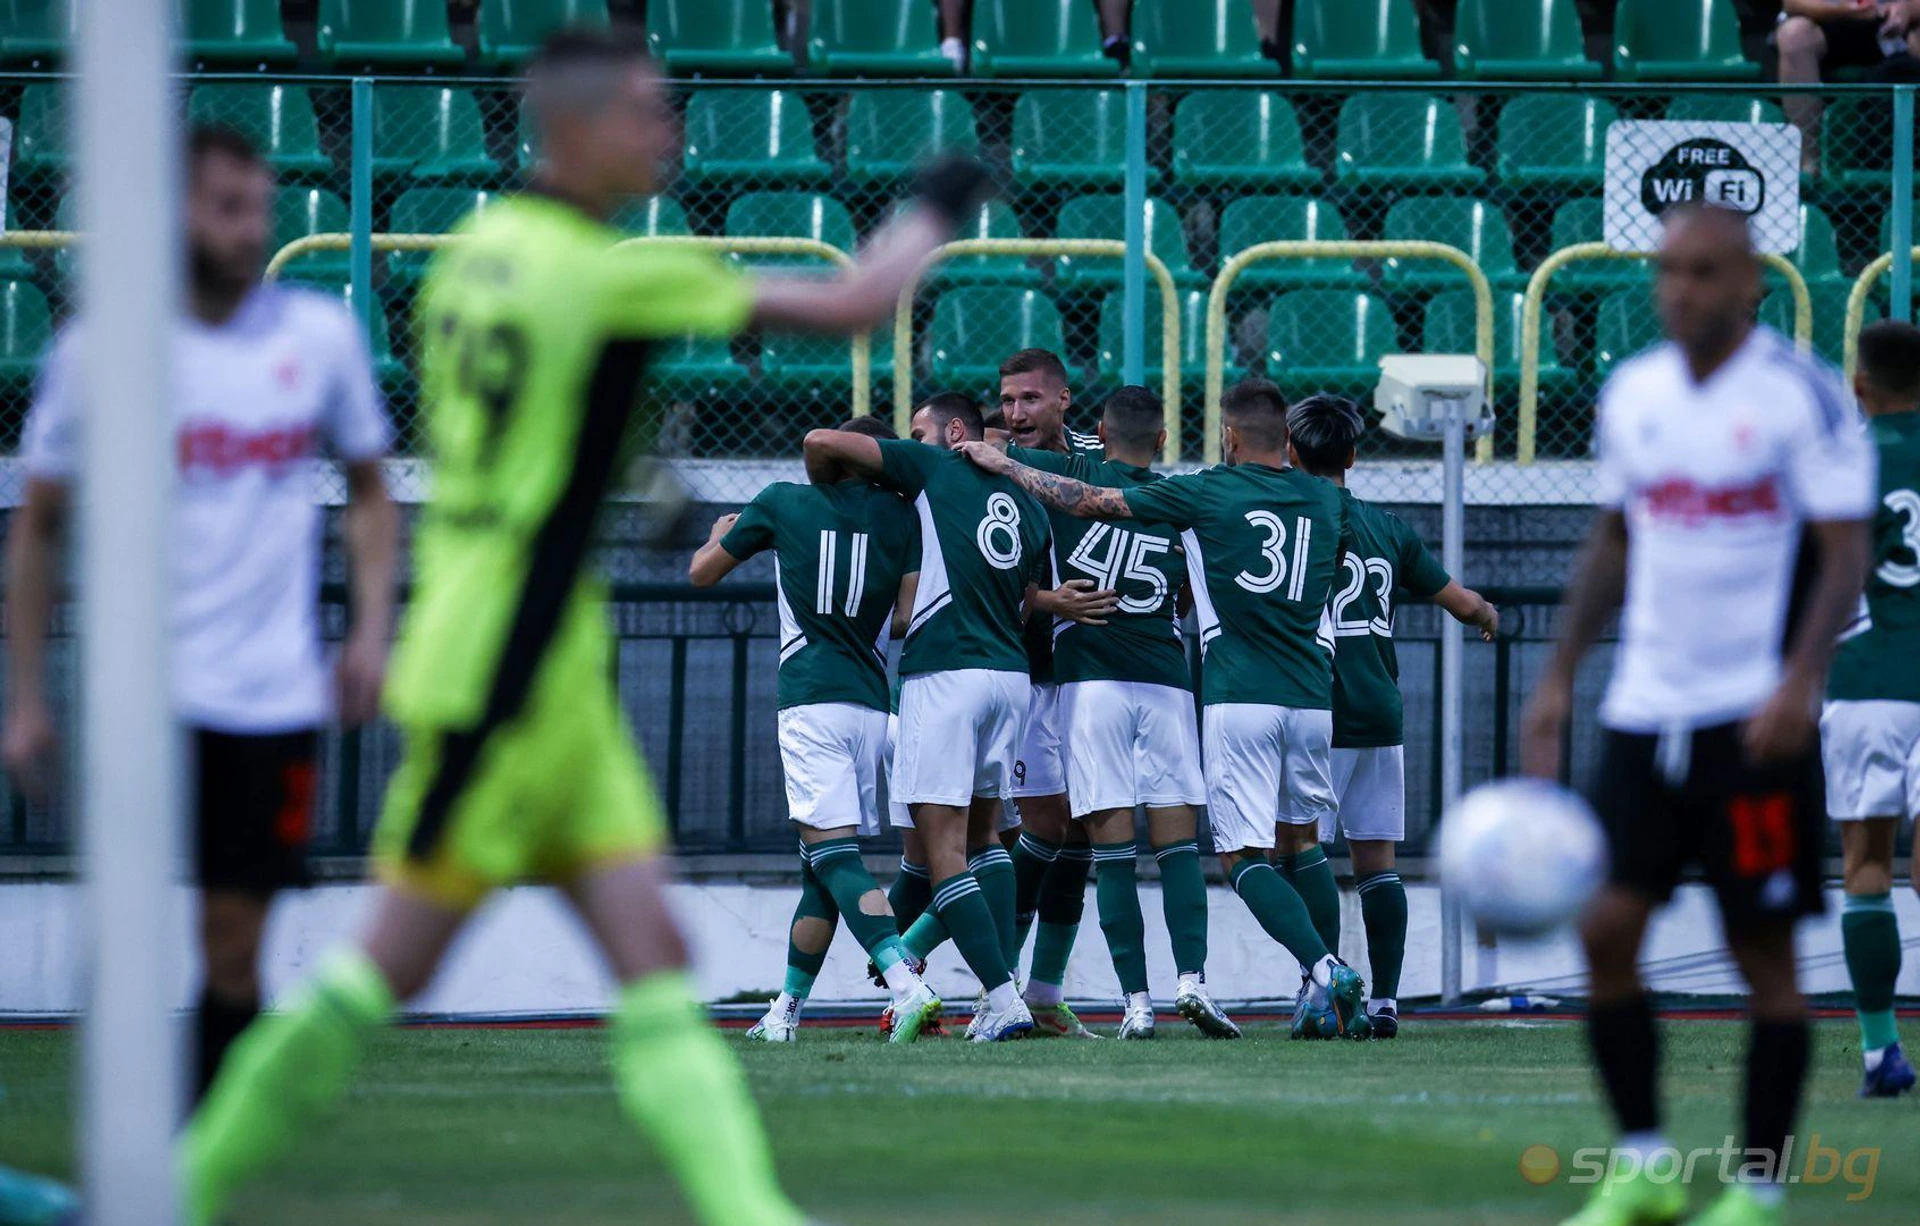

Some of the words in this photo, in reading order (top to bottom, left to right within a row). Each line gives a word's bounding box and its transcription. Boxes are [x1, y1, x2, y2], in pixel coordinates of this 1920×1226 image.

[1652, 177, 1693, 202] Wi
[1719, 180, 1745, 202] Fi
[1677, 147, 1731, 164] FREE
[977, 491, 1023, 570] 8
[1066, 520, 1170, 614] 45
[1234, 509, 1312, 603] 31
[816, 529, 869, 618] 11
[1331, 550, 1393, 638] 23
[1013, 760, 1027, 787] 9
